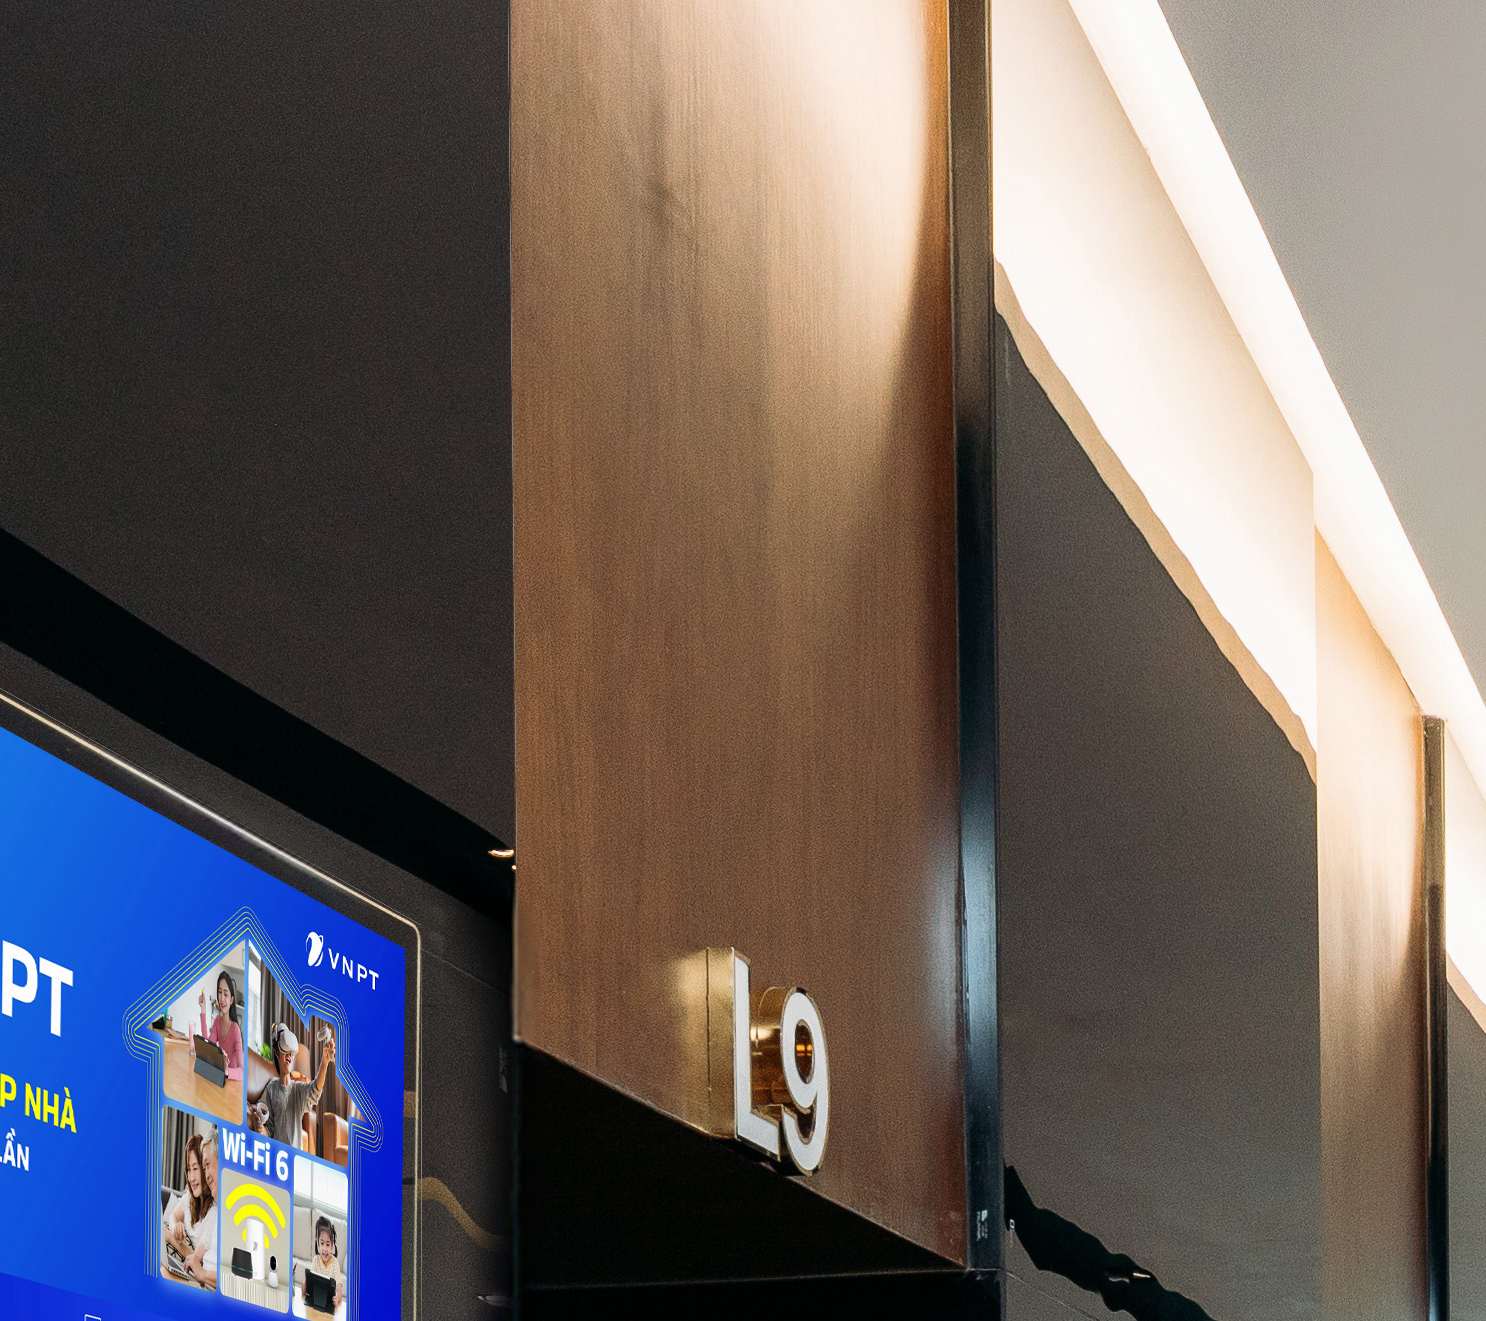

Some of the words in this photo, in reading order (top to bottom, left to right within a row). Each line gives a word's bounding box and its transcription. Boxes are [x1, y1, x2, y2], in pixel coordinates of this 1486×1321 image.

[328, 948, 379, 990] VNPT
[732, 947, 830, 1176] L9
[25, 1087, 77, 1134] NHÀ
[222, 1127, 271, 1175] Wi-Fi
[275, 1150, 289, 1181] 6
